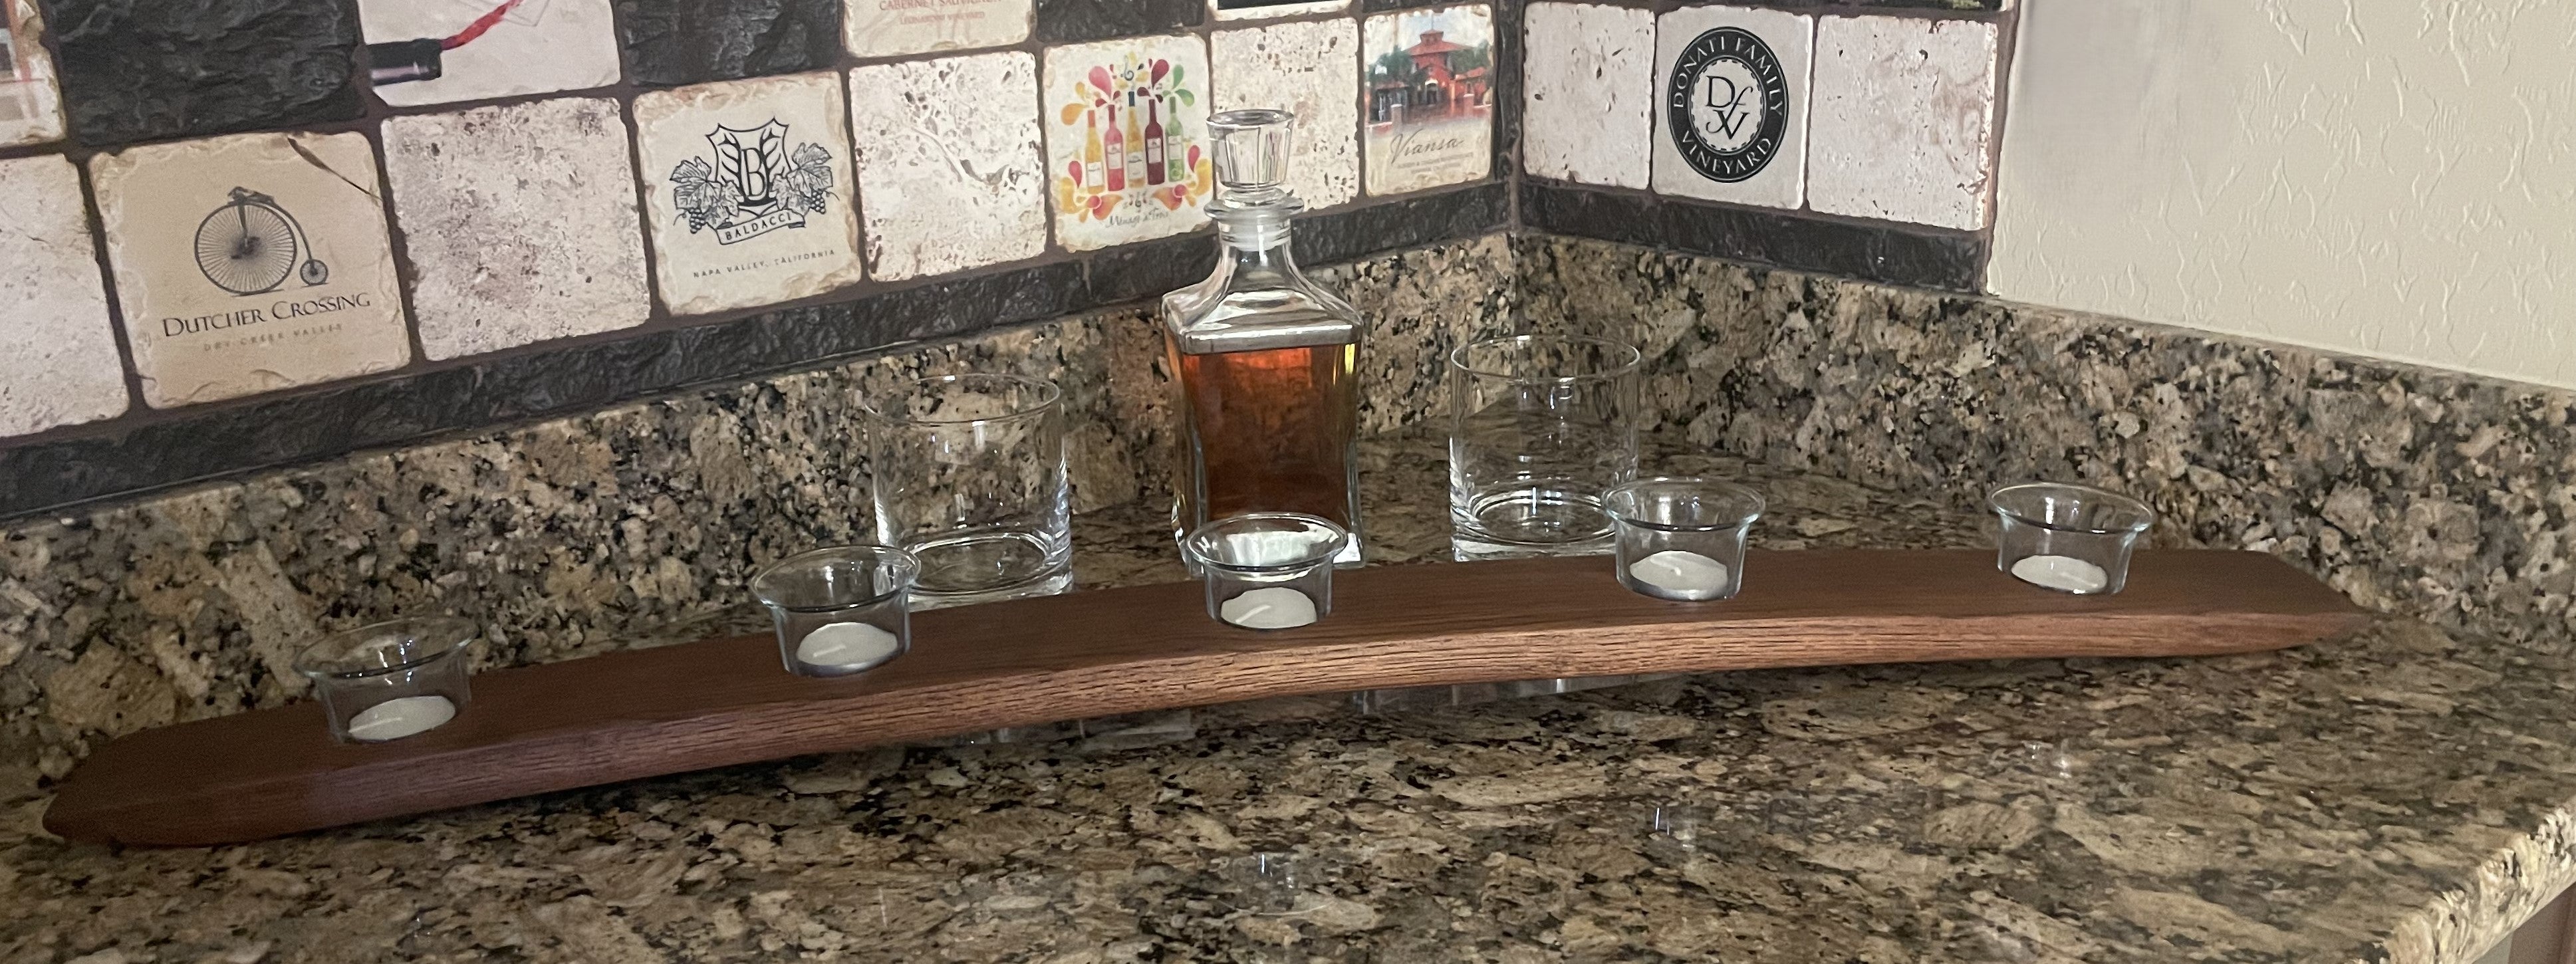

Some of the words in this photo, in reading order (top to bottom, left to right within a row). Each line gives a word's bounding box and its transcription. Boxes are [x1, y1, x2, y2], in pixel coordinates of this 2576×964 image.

[1673, 35, 1726, 108] DONATI
[1735, 37, 1783, 116] FAMILY
[1390, 128, 1465, 164] Viansa
[1682, 130, 1772, 175] VINEYARD
[741, 147, 766, 197] B
[725, 212, 793, 241] BALDACCI
[693, 268, 721, 278] NAPA
[774, 249, 835, 265] CALIFORNIA
[162, 308, 268, 337] DUTCHER
[271, 292, 371, 320] CROSSING
